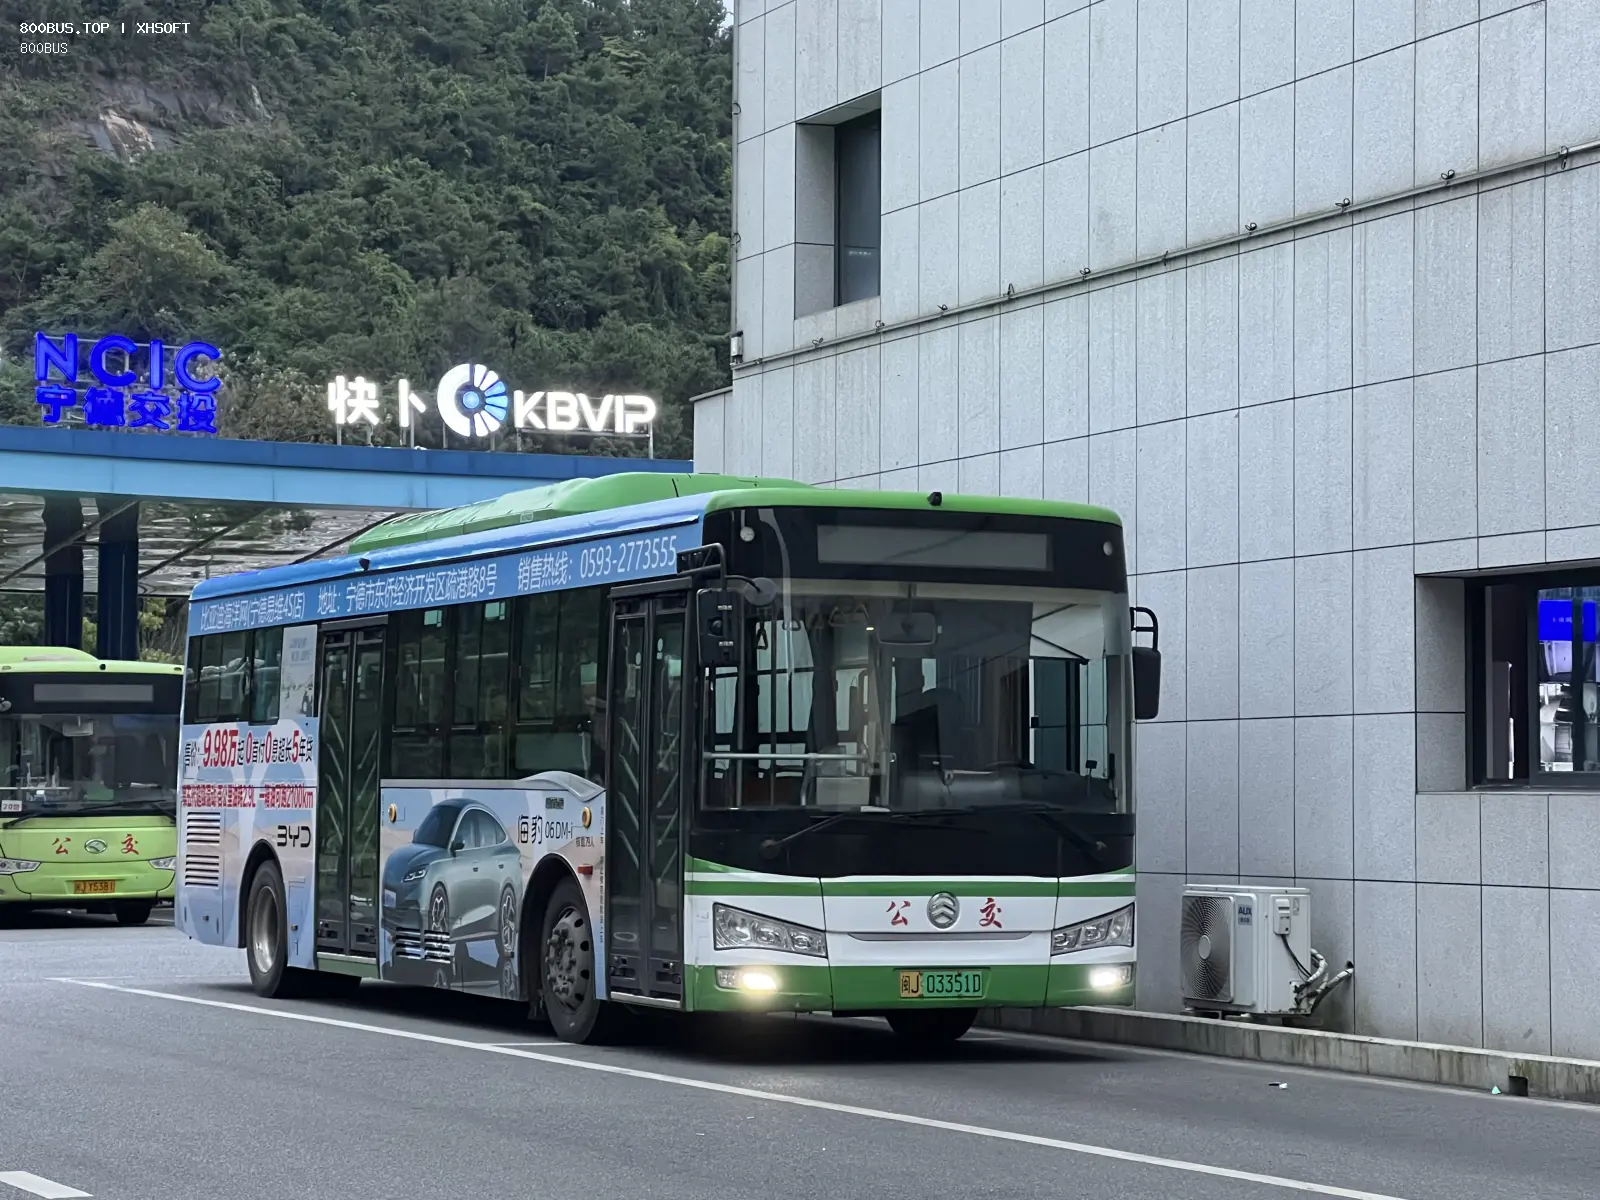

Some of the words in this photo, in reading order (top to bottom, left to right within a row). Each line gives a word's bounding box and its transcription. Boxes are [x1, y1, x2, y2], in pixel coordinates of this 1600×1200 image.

[35, 331, 221, 393] NCIC
[35, 384, 217, 434] 宁德交投
[513, 389, 656, 433] KBVIP
[277, 825, 311, 848] BYD
[886, 900, 911, 926] 公
[979, 897, 1003, 929] 交
